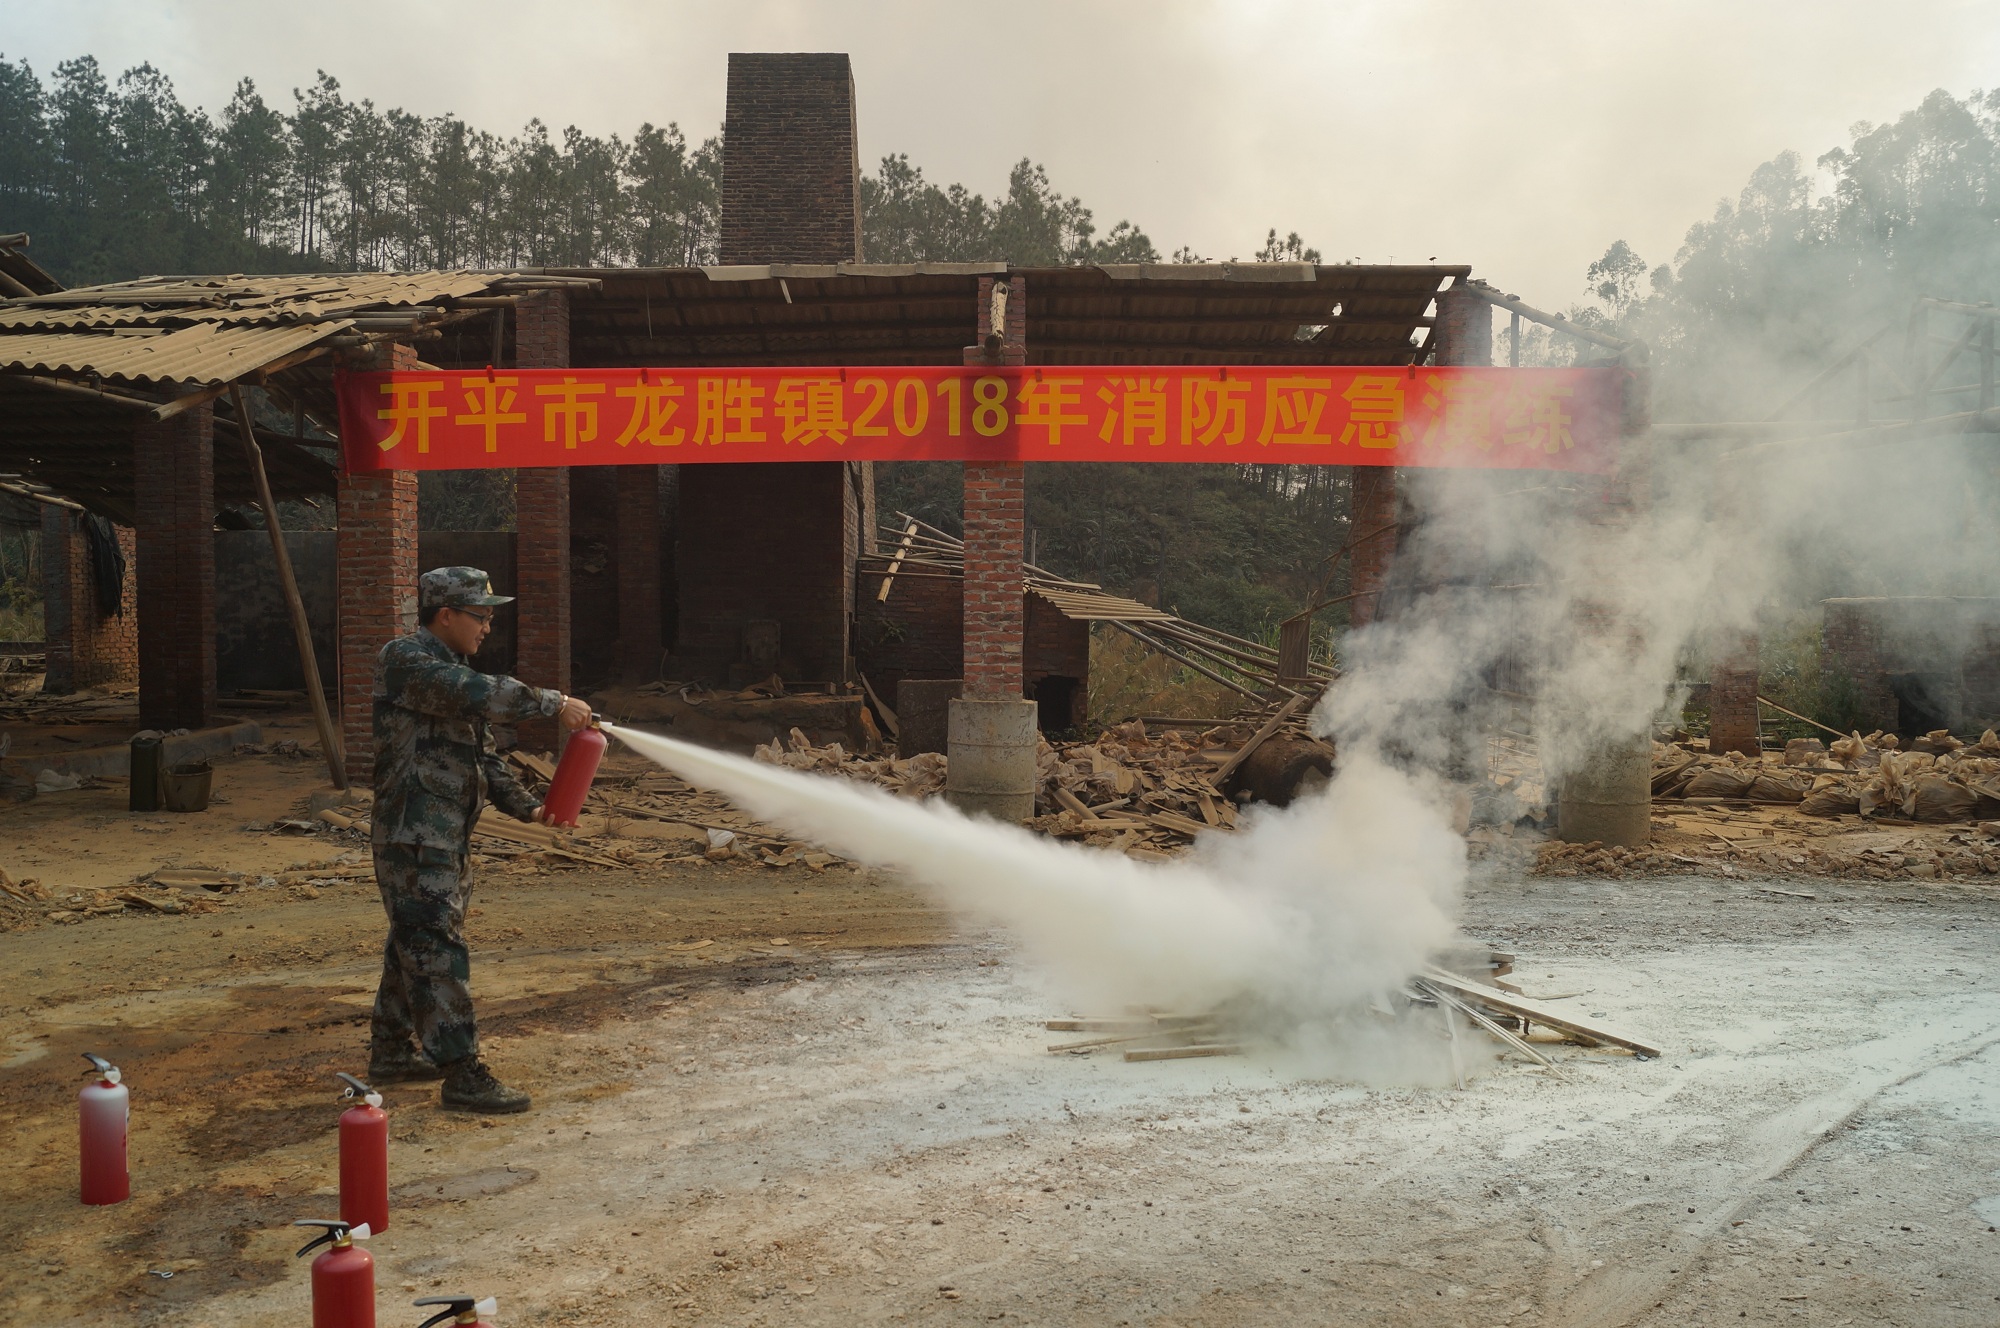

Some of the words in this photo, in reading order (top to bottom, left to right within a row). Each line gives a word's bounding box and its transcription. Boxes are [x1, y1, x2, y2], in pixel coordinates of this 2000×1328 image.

[377, 373, 1575, 454] 开平市龙胜镇2018年消防应急演练
